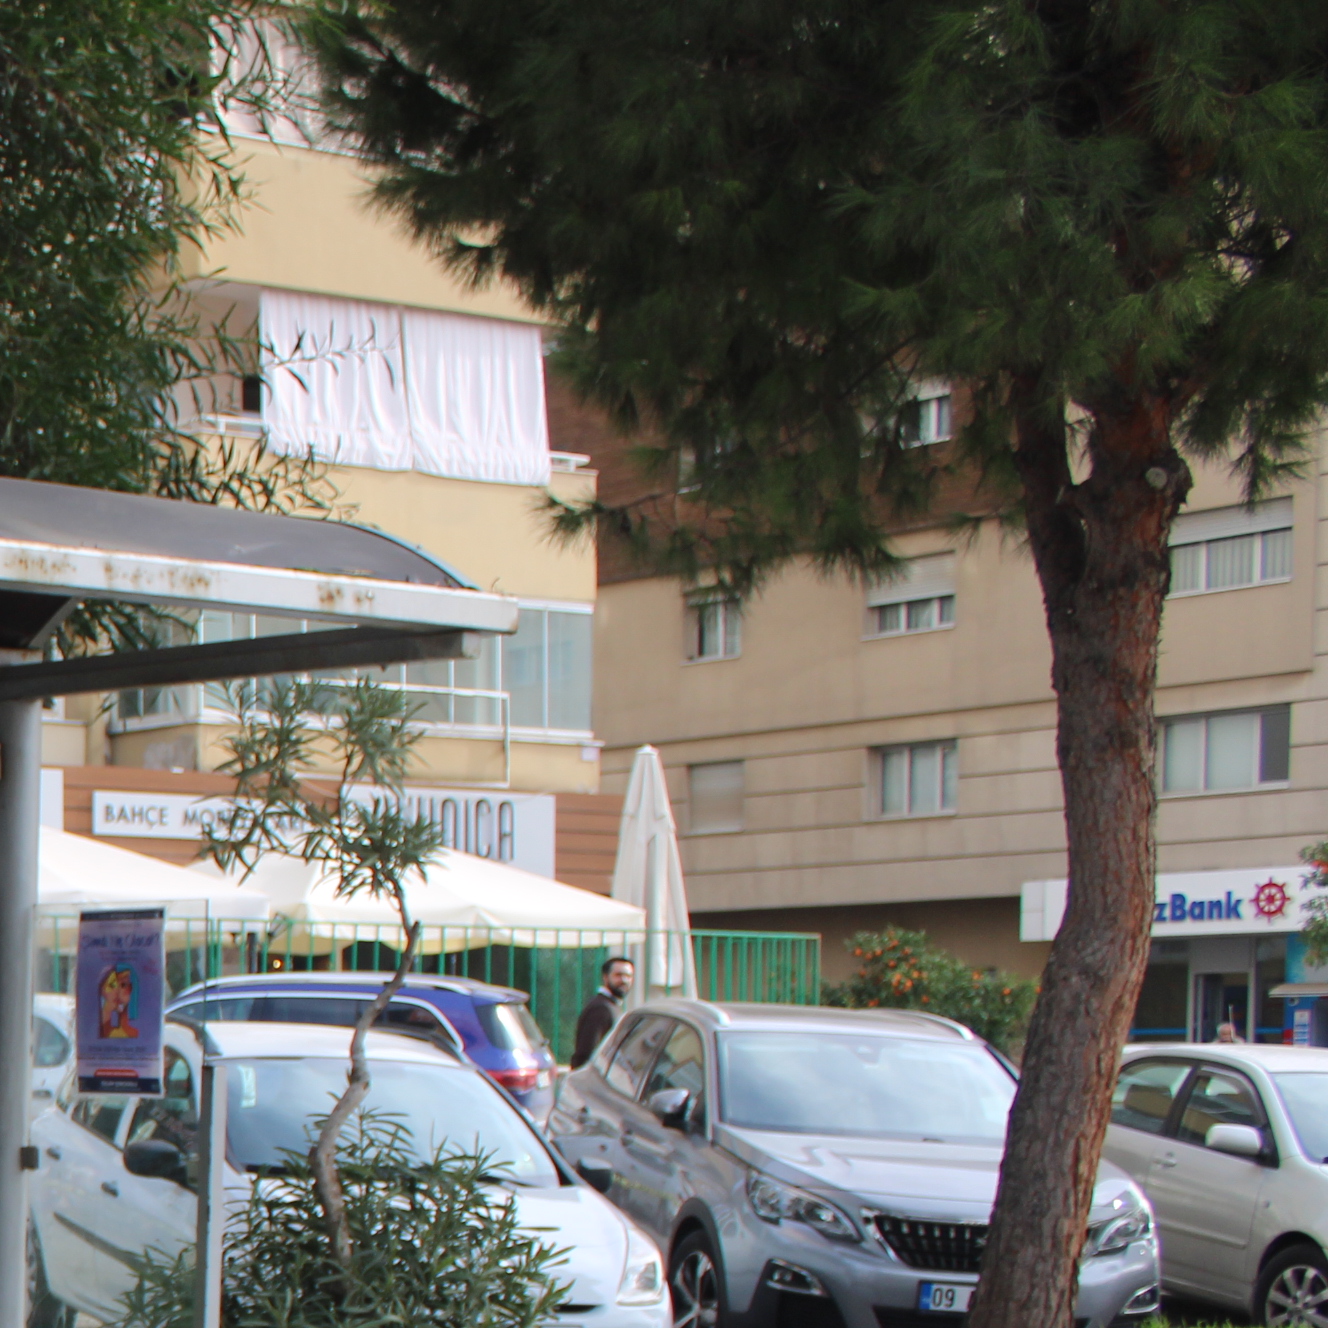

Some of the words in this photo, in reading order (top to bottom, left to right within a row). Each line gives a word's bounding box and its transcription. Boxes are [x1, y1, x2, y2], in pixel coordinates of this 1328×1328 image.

[104, 804, 170, 831] BAHÇE
[1154, 891, 1243, 922] zBank
[932, 1287, 955, 1308] 09
